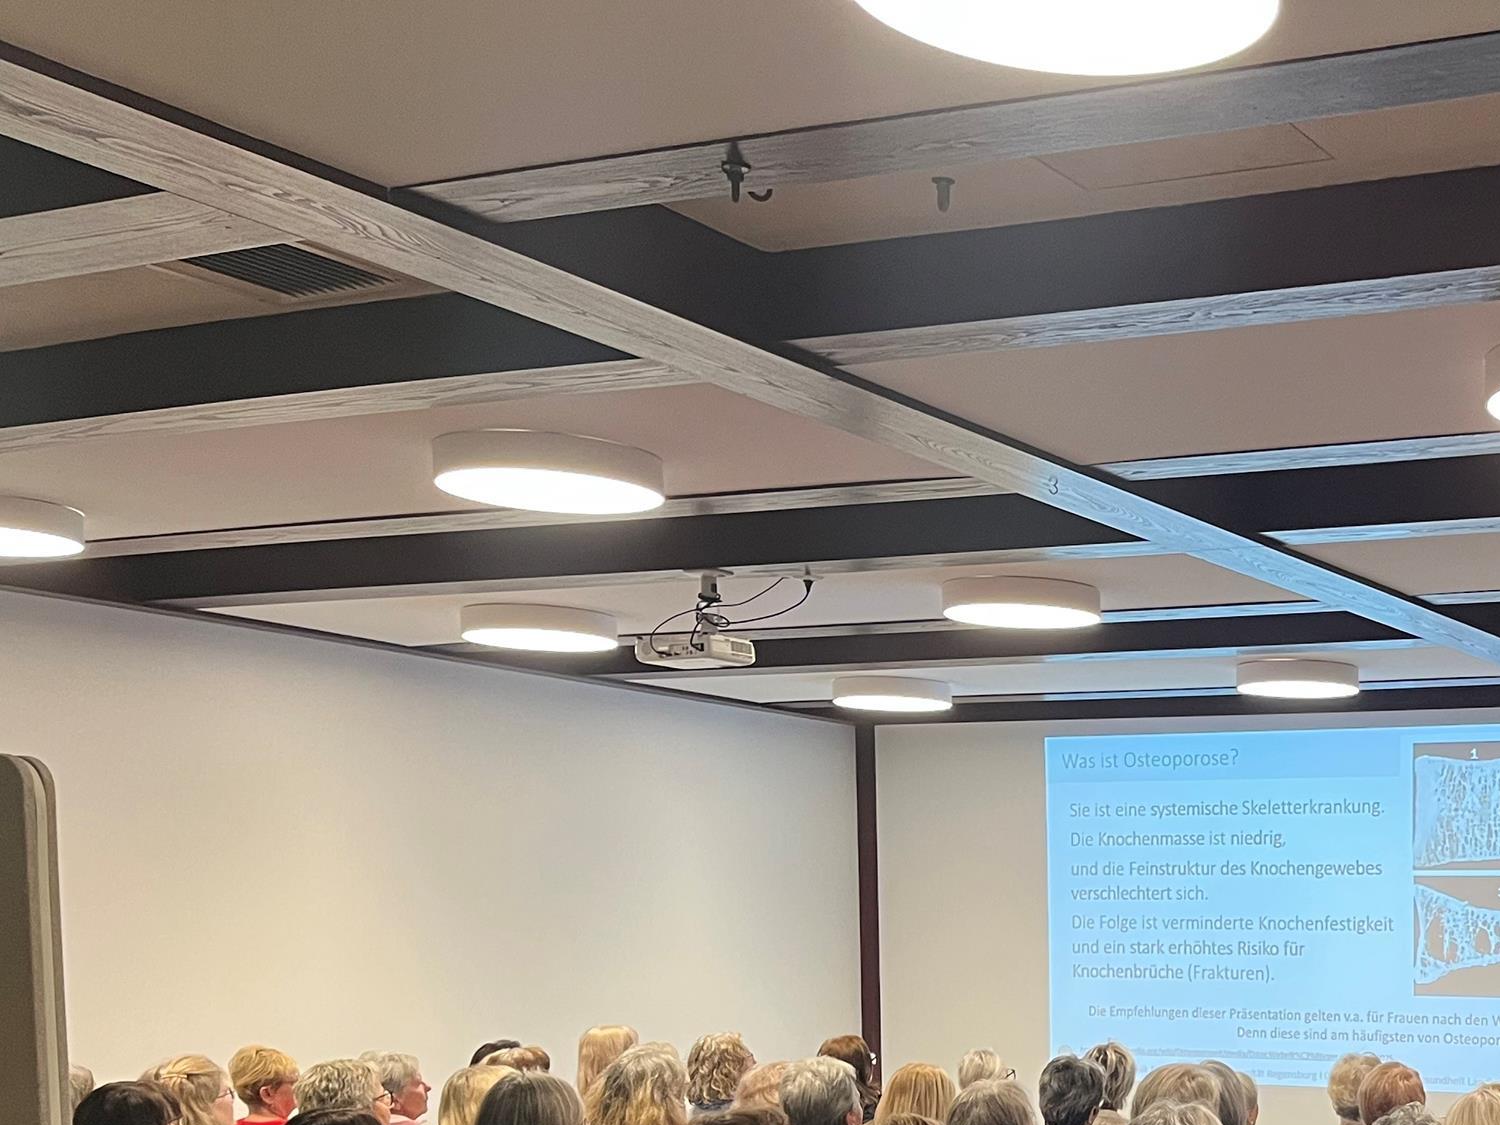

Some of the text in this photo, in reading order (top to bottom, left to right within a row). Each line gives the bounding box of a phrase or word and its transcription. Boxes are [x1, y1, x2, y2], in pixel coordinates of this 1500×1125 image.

[1062, 748, 1240, 771] Was ist Osteoporose?
[1470, 748, 1479, 760] 1
[1070, 799, 1385, 819] Sie ist eine systemische Skeletterkrankung.
[1071, 830, 1287, 849] Die Knochenmasse ist niedrig,
[1071, 860, 1383, 879] und die Feinstruktur des Knochengewebes
[1070, 885, 1209, 901] verschlechtert sich.
[1072, 914, 1394, 935] Die Folge ist verminderte Knochenfestigkeit
[1072, 939, 1305, 957] und ein stark erhöhtes Risiko für
[1072, 963, 1275, 984] Knochenbrüche (Frakturen).
[1088, 1005, 1107, 1017] Die
[1109, 1005, 1189, 1021] Empfehlungen
[1192, 1006, 1227, 1019] dieser
[1229, 1008, 1301, 1022] Präsentation
[1304, 1010, 1341, 1024] gelten
[1344, 1012, 1364, 1023] v.a.
[1367, 1010, 1384, 1023] für
[1387, 1011, 1429, 1025] Frauen
[1432, 1013, 1461, 1026] nach
[1465, 1013, 1488, 1027] den
[1237, 1027, 1267, 1039] Denn
[1270, 1027, 1300, 1040] diese
[1303, 1028, 1328, 1041] sind
[1331, 1030, 1349, 1041] am
[1352, 1029, 1415, 1045] häufigsten
[1417, 1033, 1440, 1044] von
